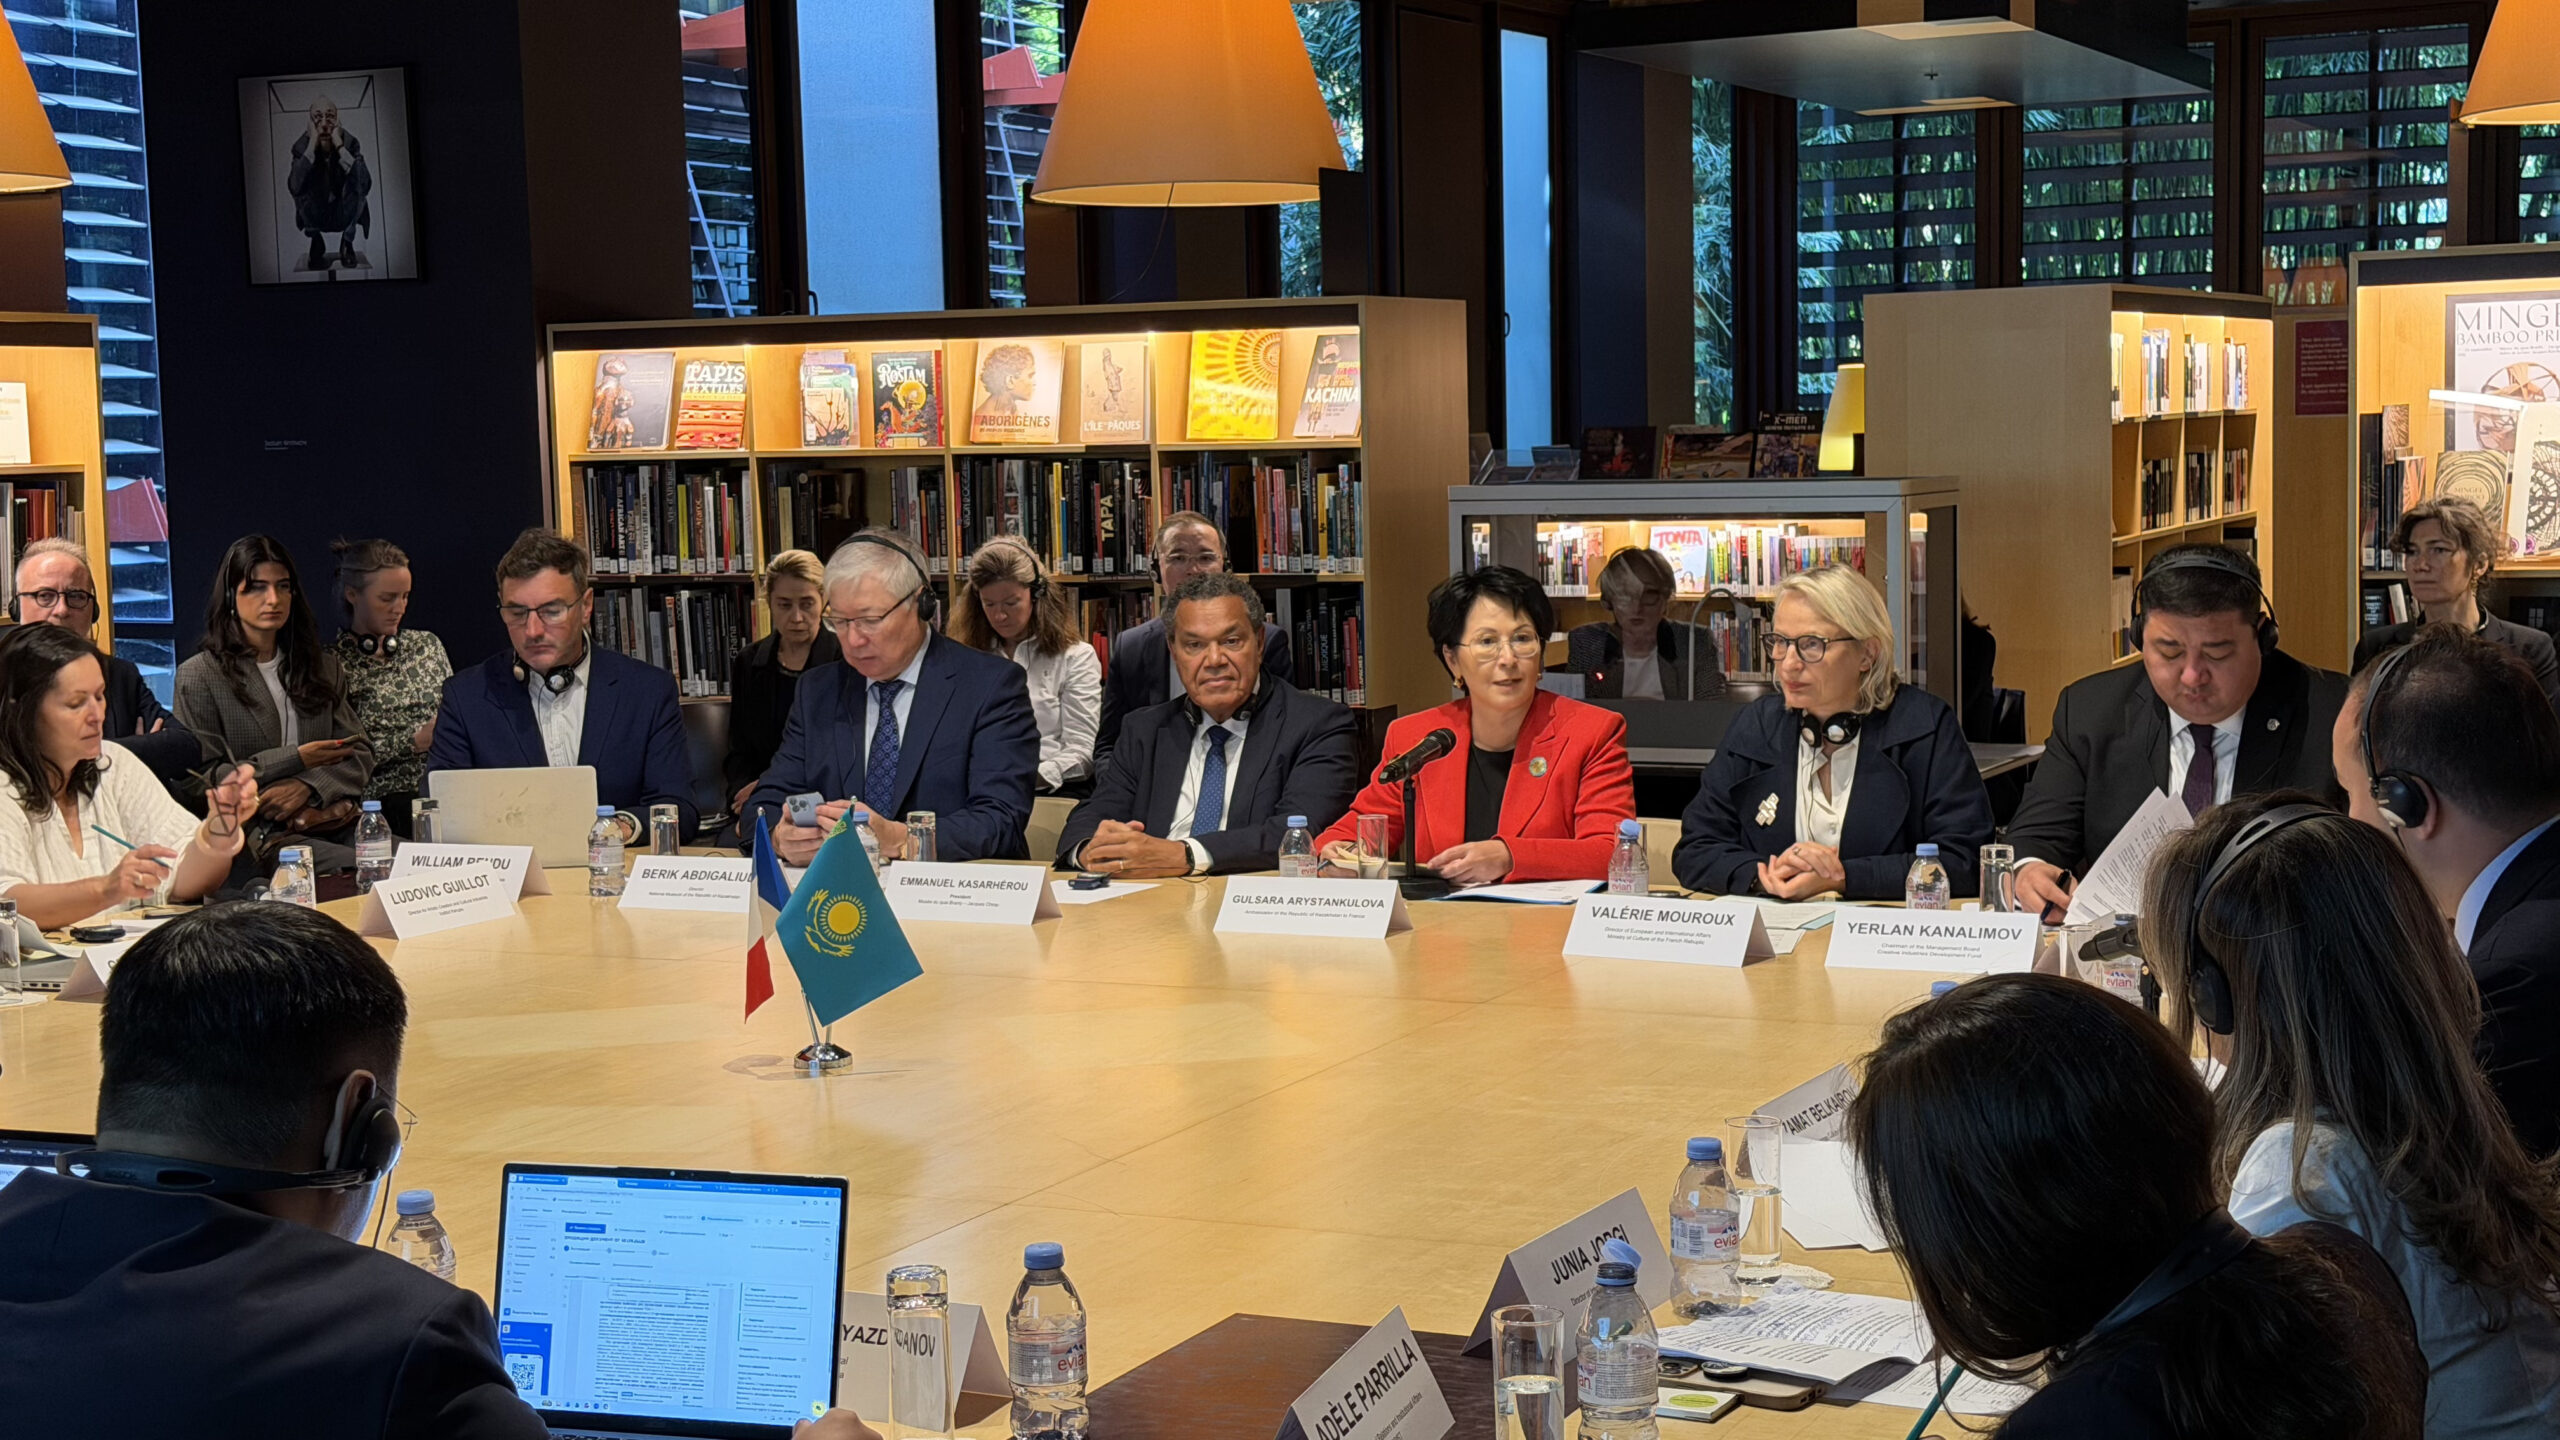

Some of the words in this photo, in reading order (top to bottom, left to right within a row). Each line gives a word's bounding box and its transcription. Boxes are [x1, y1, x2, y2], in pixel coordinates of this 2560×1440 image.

[2457, 330, 2529, 346] BAMBOO
[686, 363, 746, 383] TAPIS
[876, 363, 928, 389] ROSTAM
[683, 383, 744, 394] TEXTILES
[1304, 386, 1359, 403] KACHINA
[980, 412, 1051, 428] ABORIGÈNES
[1107, 419, 1141, 432] PÂQUES
[1100, 494, 1115, 541] TAPA
[1654, 530, 1704, 549] TONTA
[729, 625, 739, 659] Ghana
[1319, 634, 1329, 672] MEXIQUE
[411, 854, 464, 868] WILLIAM
[641, 868, 680, 880] BERIK
[389, 884, 441, 905] LUDOVIC
[442, 874, 490, 894] GUILLOT
[900, 876, 955, 888] EMMANUEL
[958, 878, 1029, 891] KASARHÉROU
[1611, 883, 1632, 891] evian
[1232, 895, 1284, 905] GULSARA
[1287, 896, 1385, 909] ARYSTANKULOVA
[1914, 901, 1939, 909] evian
[1592, 905, 1654, 922] VALÉRIE
[1657, 910, 1736, 926] MOUROUX
[1847, 921, 1915, 936] YERLAN
[1919, 925, 2023, 941] KANALIMOV
[2106, 976, 2133, 988] evian
[1551, 1246, 1592, 1285] JUNIA
[1315, 1391, 1364, 1440] ADÈLE
[1353, 1338, 1419, 1412] PARRILLA
